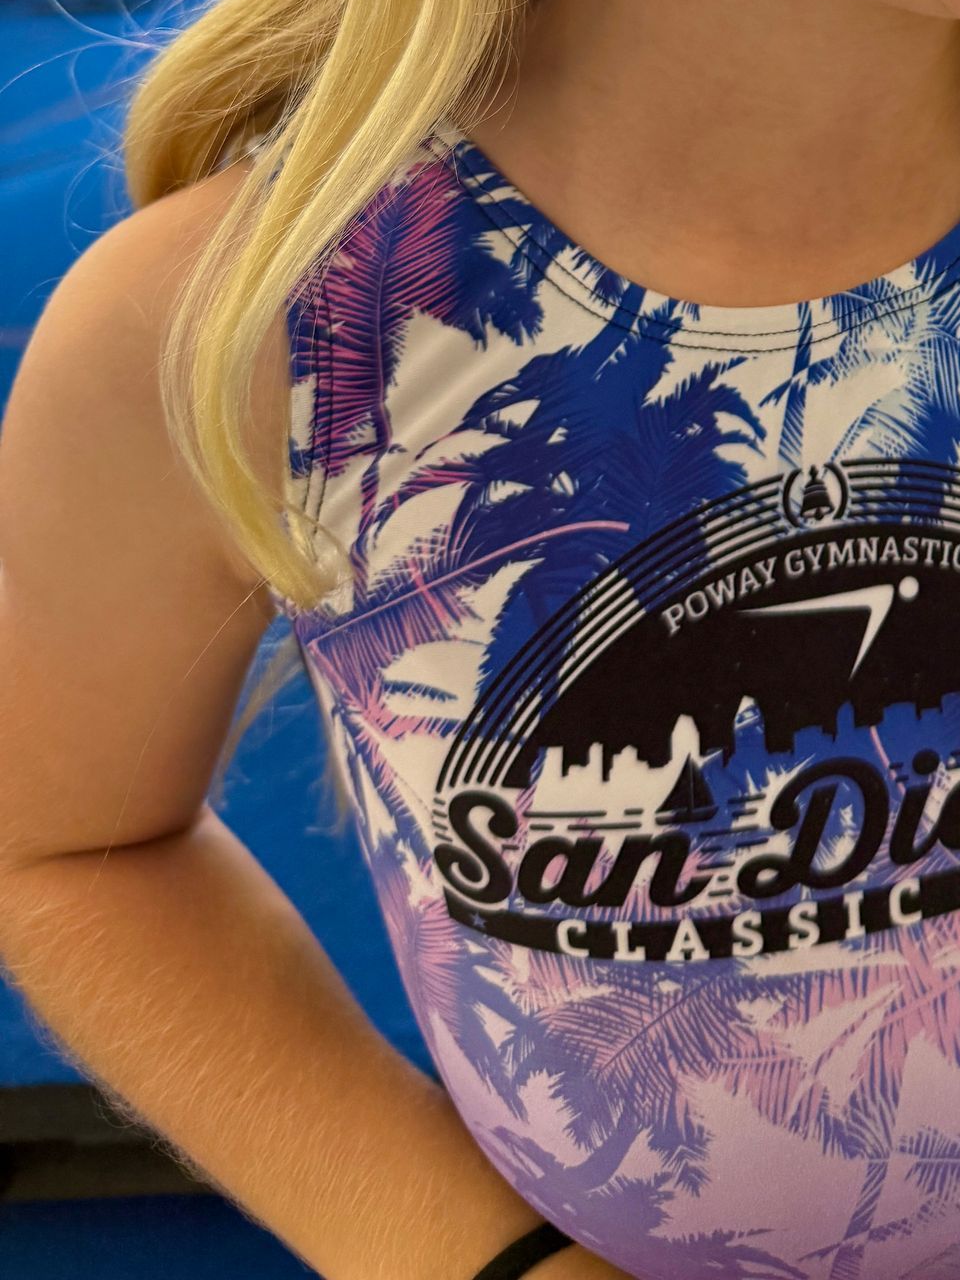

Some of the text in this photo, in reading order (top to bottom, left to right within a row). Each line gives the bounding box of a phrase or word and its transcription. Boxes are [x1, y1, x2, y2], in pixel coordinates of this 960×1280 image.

[661, 556, 777, 636] POWAY
[433, 790, 713, 908] San
[556, 877, 923, 962] CLASSIC
